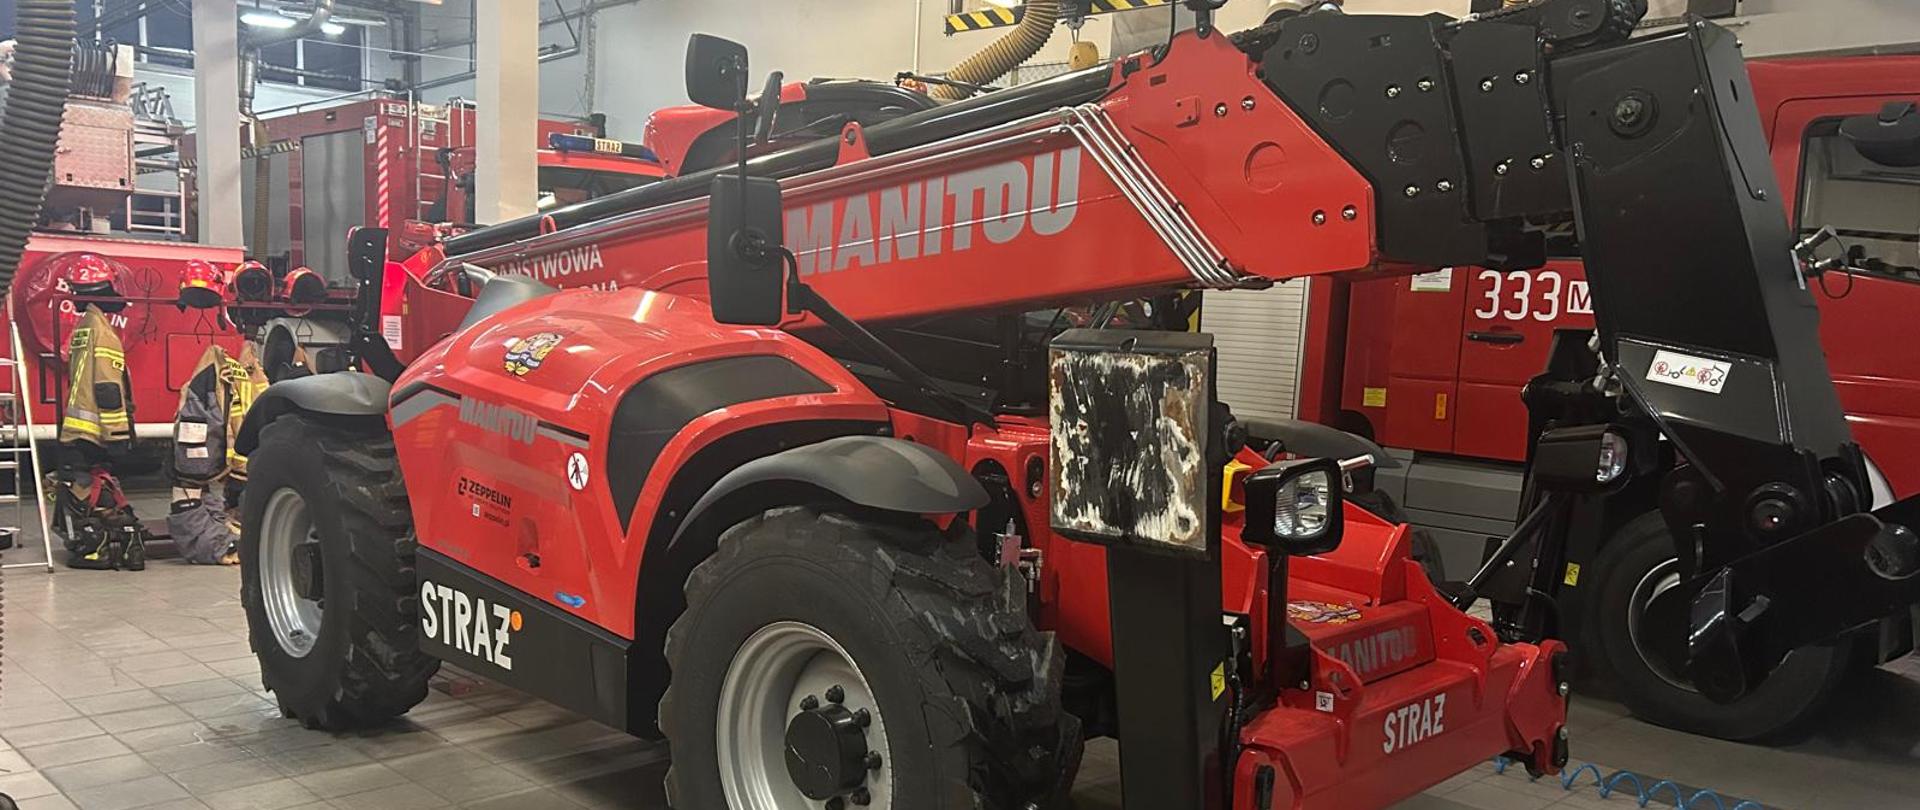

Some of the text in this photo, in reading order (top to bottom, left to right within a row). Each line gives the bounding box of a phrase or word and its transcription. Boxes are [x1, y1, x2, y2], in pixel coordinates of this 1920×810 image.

[783, 147, 1082, 275] MANITOU
[80, 269, 89, 281] 2
[1475, 269, 1561, 321] 333
[460, 395, 538, 445] MANITOU
[469, 480, 511, 508] ZEPPELIN
